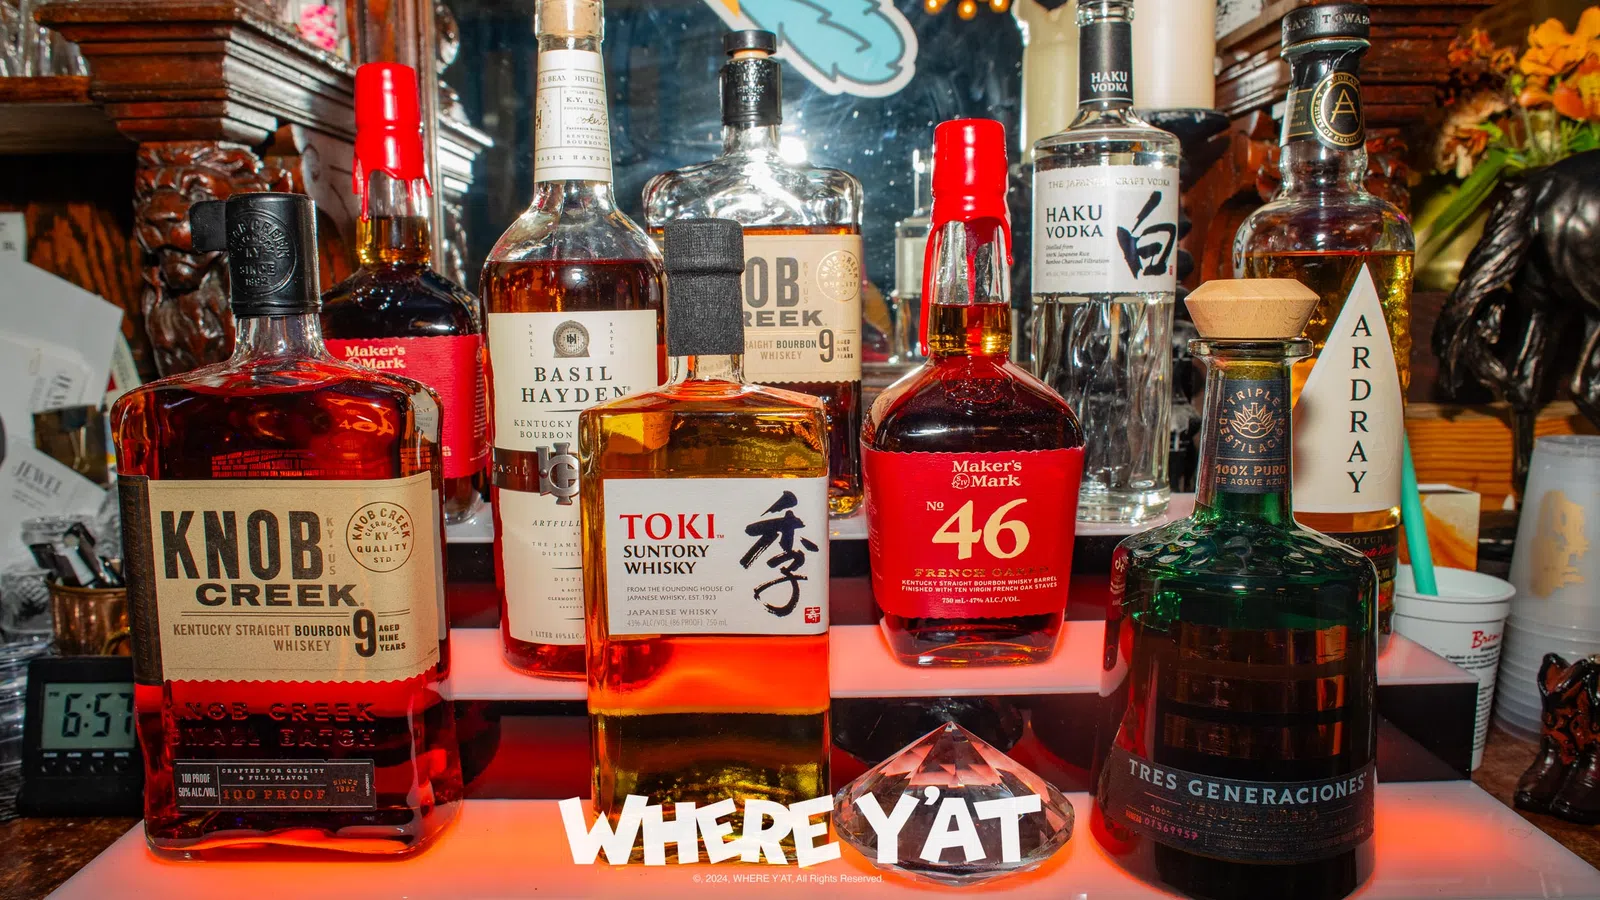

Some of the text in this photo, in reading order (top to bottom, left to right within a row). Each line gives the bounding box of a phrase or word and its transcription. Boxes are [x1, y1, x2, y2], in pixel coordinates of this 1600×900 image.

[1091, 71, 1127, 83] HAKU
[1091, 83, 1128, 92] VODKA
[1048, 181, 1063, 189] THE
[1046, 205, 1103, 223] HAKU
[1045, 224, 1104, 239] VODKA
[1116, 190, 1177, 280] 白
[240, 262, 276, 276] SINCE
[745, 256, 800, 308] OB
[744, 309, 824, 327] REEK
[776, 339, 817, 349] BOURBON
[819, 329, 834, 363] 9
[345, 345, 406, 357] Maker's
[760, 351, 802, 361] WHISKEY
[360, 358, 406, 369] Mark
[534, 366, 613, 382] BASIL
[1227, 388, 1281, 406] TRIPLE
[1346, 314, 1373, 494] ARDRAY
[514, 419, 573, 427] KENTUCKY
[520, 430, 573, 439] BOURBON
[952, 460, 1022, 473] Maker's
[1216, 464, 1287, 477] 100% PURO
[970, 474, 1021, 487] Mark
[1216, 477, 1226, 485] DE
[1230, 478, 1262, 486] AGAVE
[352, 507, 411, 540] KNOB CREEK
[365, 520, 399, 537] CLERMONT
[931, 498, 1031, 560] 46
[375, 531, 389, 541] KY
[160, 509, 324, 581] KNOB
[356, 543, 407, 553] QUALITY
[623, 544, 710, 558] SUNTORY
[623, 561, 696, 575] WHISKY
[914, 568, 986, 578] FRENCH
[902, 579, 937, 587] KENTUCKY
[1035, 582, 1057, 590] STAVES
[196, 583, 360, 607] CREEK
[173, 624, 351, 637] KENTUCKY STRAIGHT BOURBON
[352, 609, 376, 658] 9
[378, 623, 400, 632] AGED
[379, 633, 400, 642] NINE
[273, 640, 331, 652] WHISKEY
[379, 642, 406, 652] YEARS
[62, 692, 133, 738] 6:57
[269, 702, 376, 721] CREEK
[181, 773, 211, 784] 100 PROOF
[333, 778, 358, 786] SINCE
[1128, 758, 1366, 806] TRES GENERACIONES
[178, 787, 191, 797] 50%
[222, 789, 326, 801] 100 PROOF
